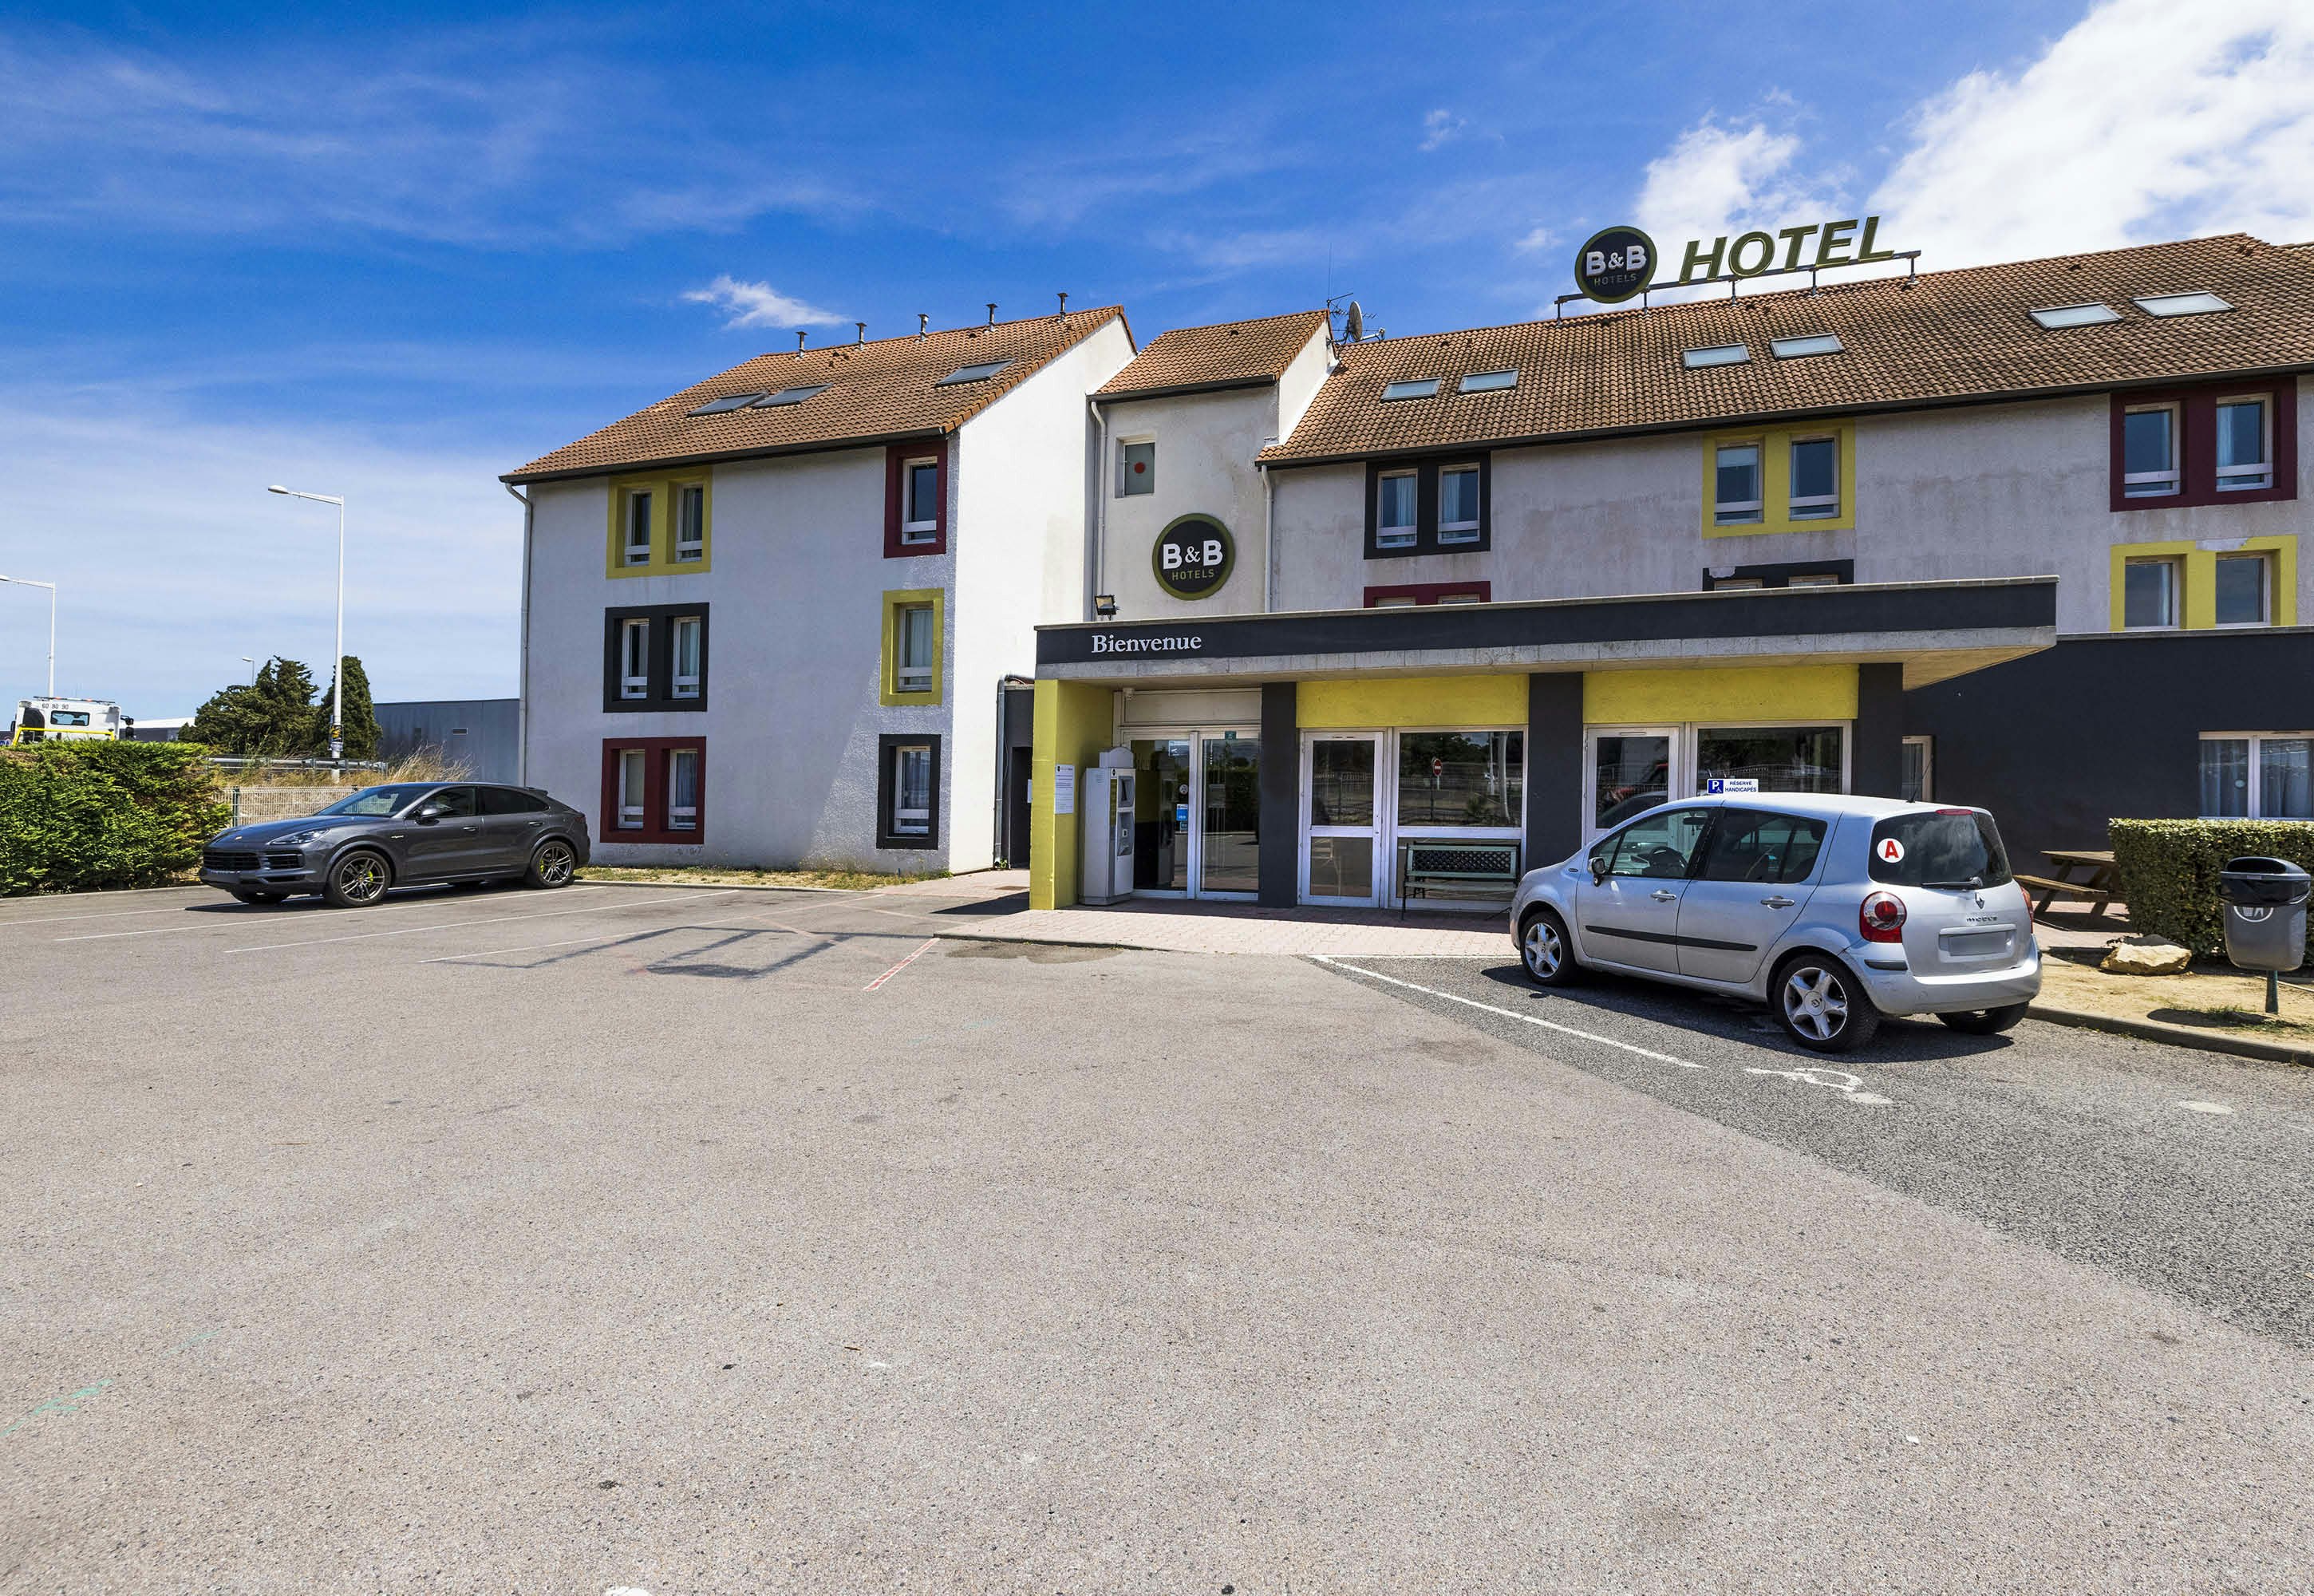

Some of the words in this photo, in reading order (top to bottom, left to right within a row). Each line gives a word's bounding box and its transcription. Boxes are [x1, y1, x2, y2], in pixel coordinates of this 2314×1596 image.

[1679, 216, 1895, 283] HOTEL
[1586, 245, 1647, 276] B&B
[1594, 273, 1637, 286] HOTELS
[1163, 539, 1223, 570] B&B
[1172, 569, 1214, 581] HOTELS
[1091, 634, 1202, 654] Bienvenue
[1712, 780, 1720, 790] P
[1885, 840, 1899, 858] A
